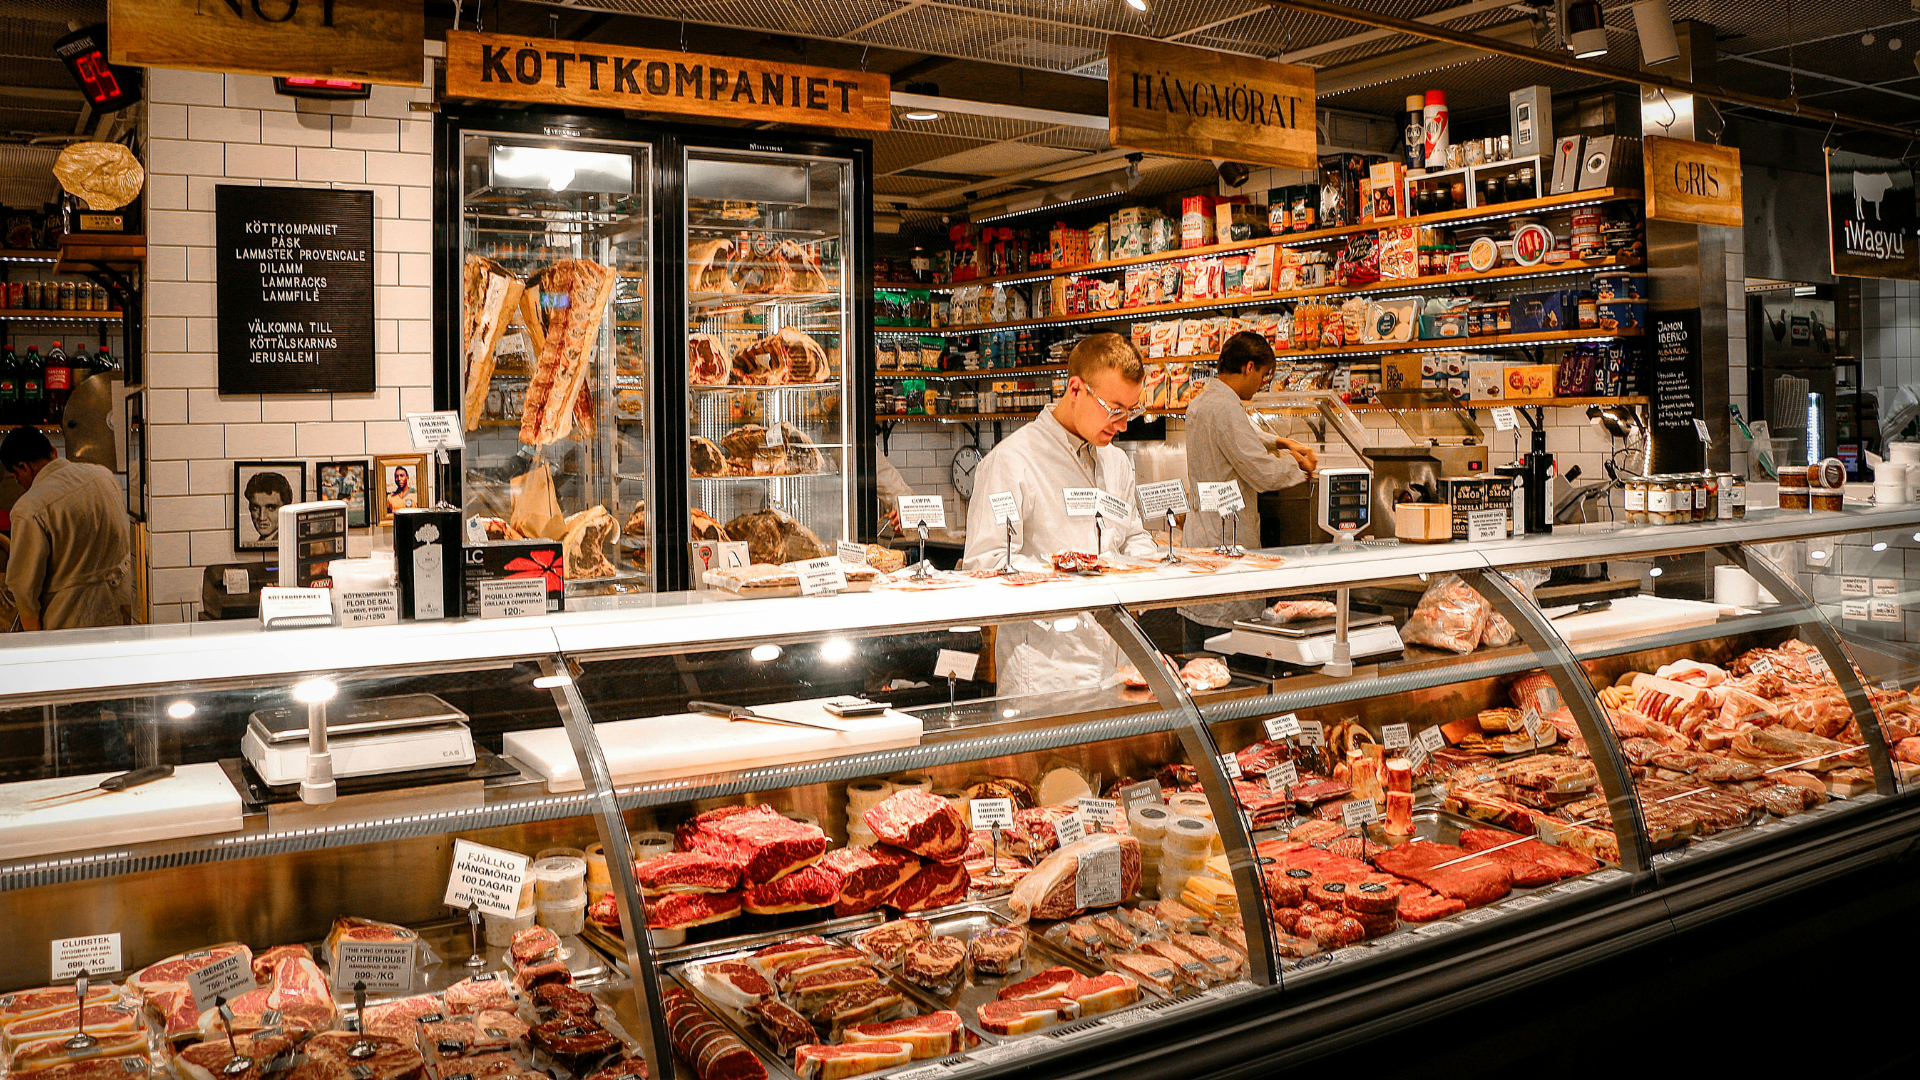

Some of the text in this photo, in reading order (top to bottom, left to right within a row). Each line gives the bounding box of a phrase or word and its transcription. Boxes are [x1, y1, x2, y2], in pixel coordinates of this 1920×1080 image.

[481, 43, 858, 113] KÖTTKOMPANIET
[1132, 70, 1303, 129] HÄNGMÖRAT
[1673, 160, 1719, 199] GRIS
[245, 220, 338, 236] KÖTTKOMPANIET
[271, 234, 301, 249] PÅSK
[1845, 219, 1905, 260] iWagyu
[235, 248, 294, 260] LAMMSTEK
[260, 262, 303, 274] DILAMM
[262, 276, 328, 288] LAMMRACKS
[248, 318, 333, 333] VÄLKOMNA TILL
[249, 334, 338, 349] KÖTTÄLSKARNAS
[1457, 490, 1480, 499] SMÖR
[1488, 488, 1511, 497] SMÖR
[465, 549, 484, 564] LC
[808, 561, 830, 569] TAPAS
[346, 599, 364, 607] FLOR
[378, 598, 392, 606] SAL
[503, 607, 525, 616] 120:-
[467, 852, 515, 871] FJÄLLKO
[457, 861, 521, 883] HÄNGMÖRAD
[461, 874, 513, 894] 100 DAGAR
[477, 897, 510, 911] DALARNA
[62, 936, 110, 948] CLUBSTEK
[196, 955, 239, 979] T-BENSTEK
[344, 955, 407, 964] PORTERHOUSE
[354, 971, 394, 980] 899:-/KG
